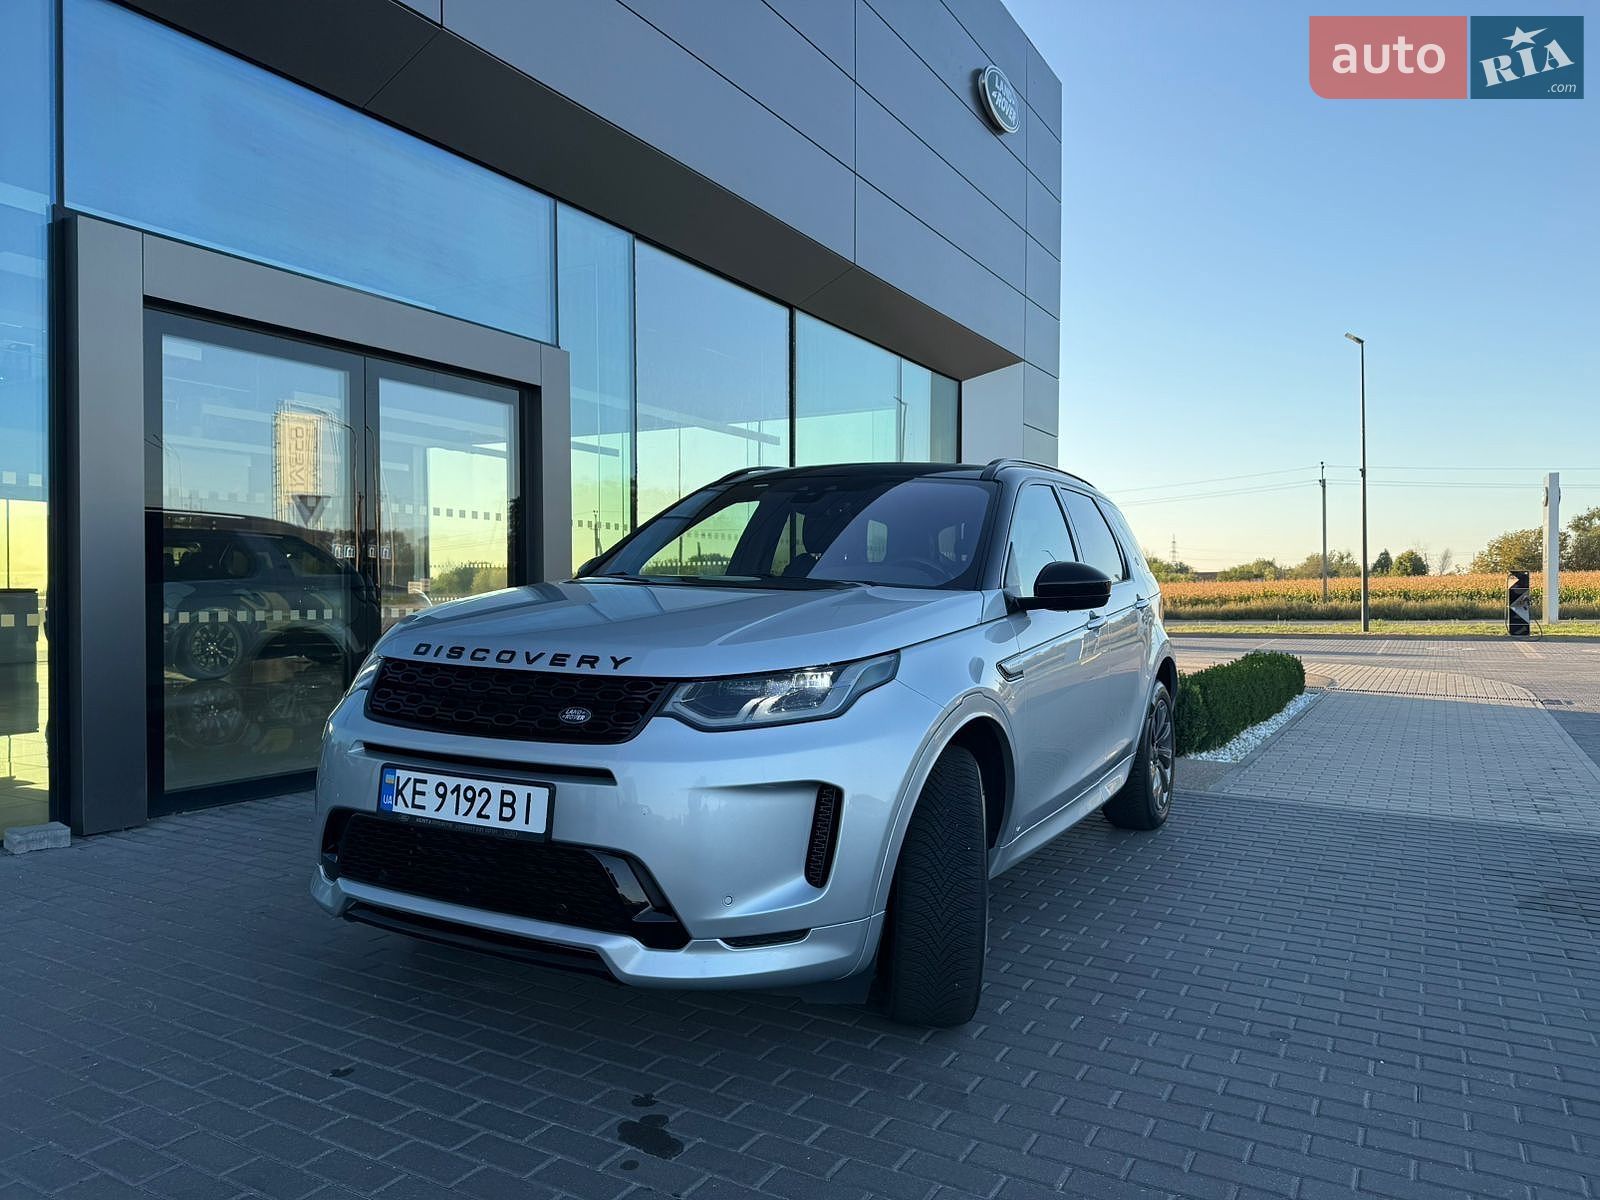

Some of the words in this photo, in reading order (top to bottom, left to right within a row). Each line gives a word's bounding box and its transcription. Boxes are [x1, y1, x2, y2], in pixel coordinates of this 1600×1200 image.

[413, 643, 632, 670] DISCOVERY
[383, 794, 393, 805] UA
[394, 775, 428, 810] KE
[434, 781, 491, 820] 9192
[498, 789, 532, 825] BI
